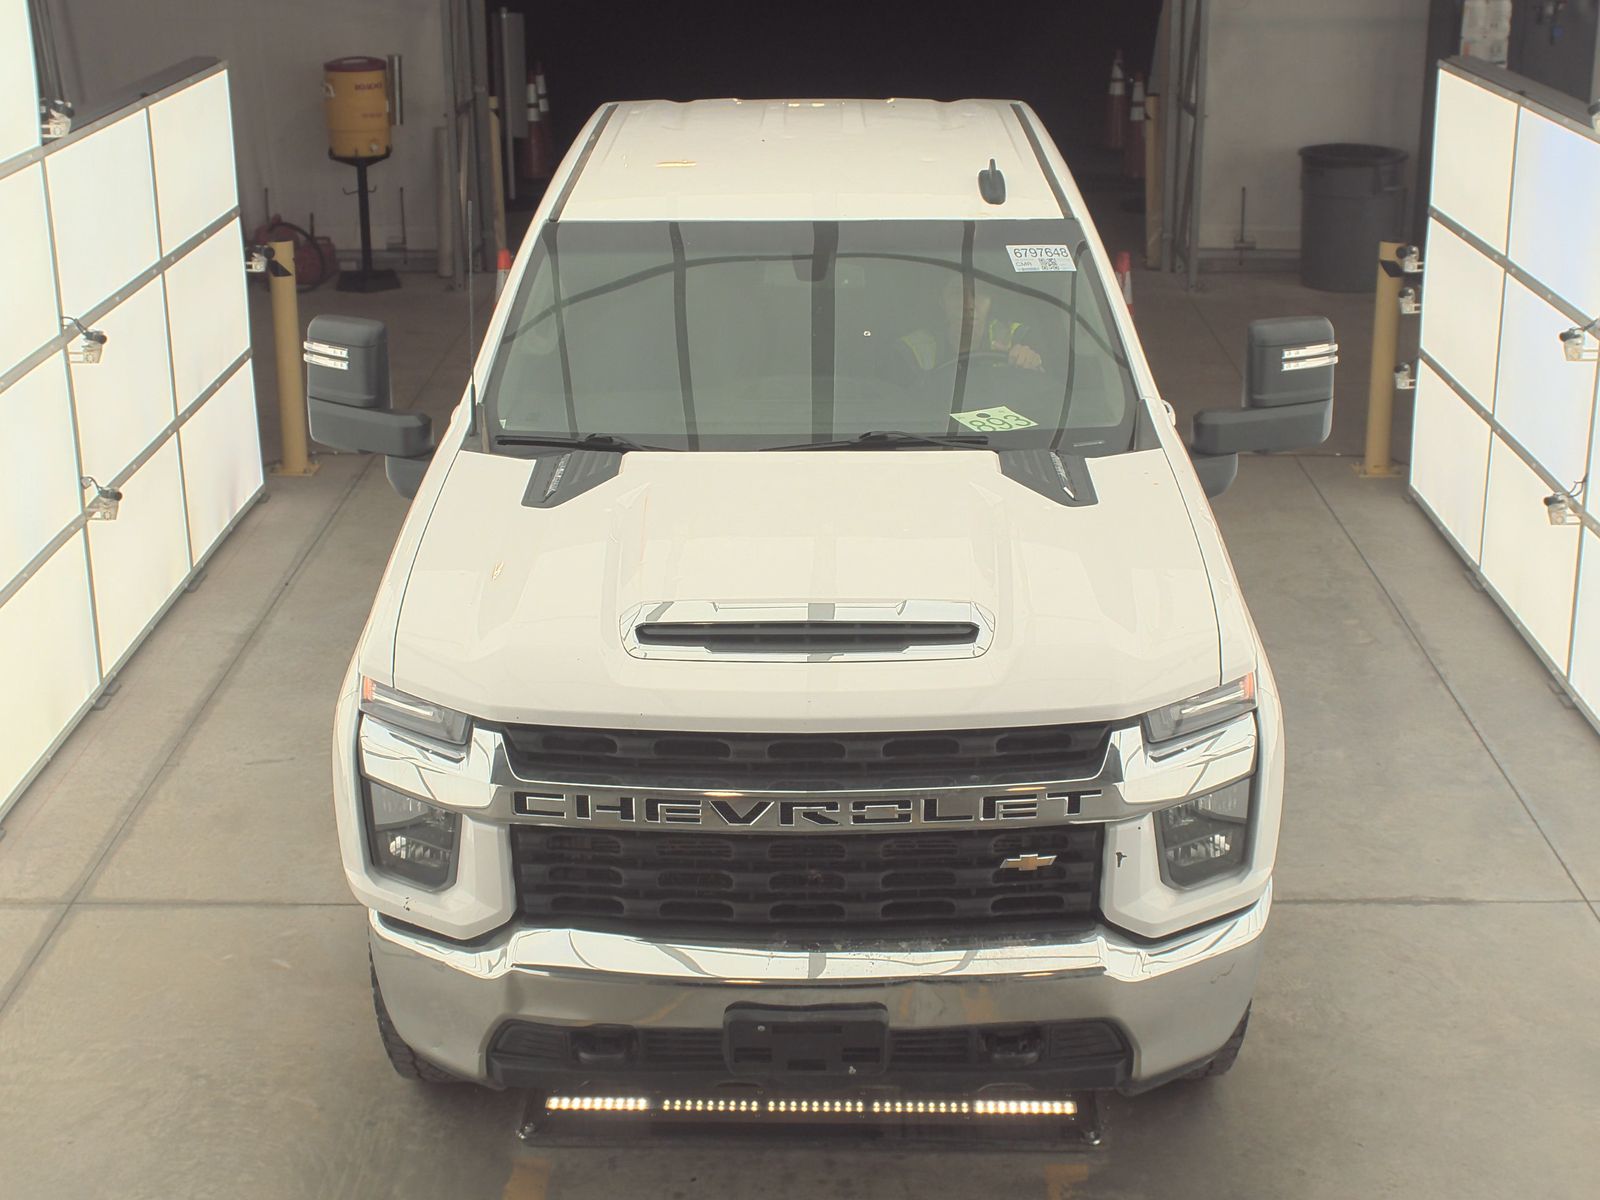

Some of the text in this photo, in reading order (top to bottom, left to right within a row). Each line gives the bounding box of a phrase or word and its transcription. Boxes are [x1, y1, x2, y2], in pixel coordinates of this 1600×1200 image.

[1013, 247, 1069, 258] 6797648
[969, 414, 1031, 432] 893
[512, 789, 1103, 827] CHEVROLET
